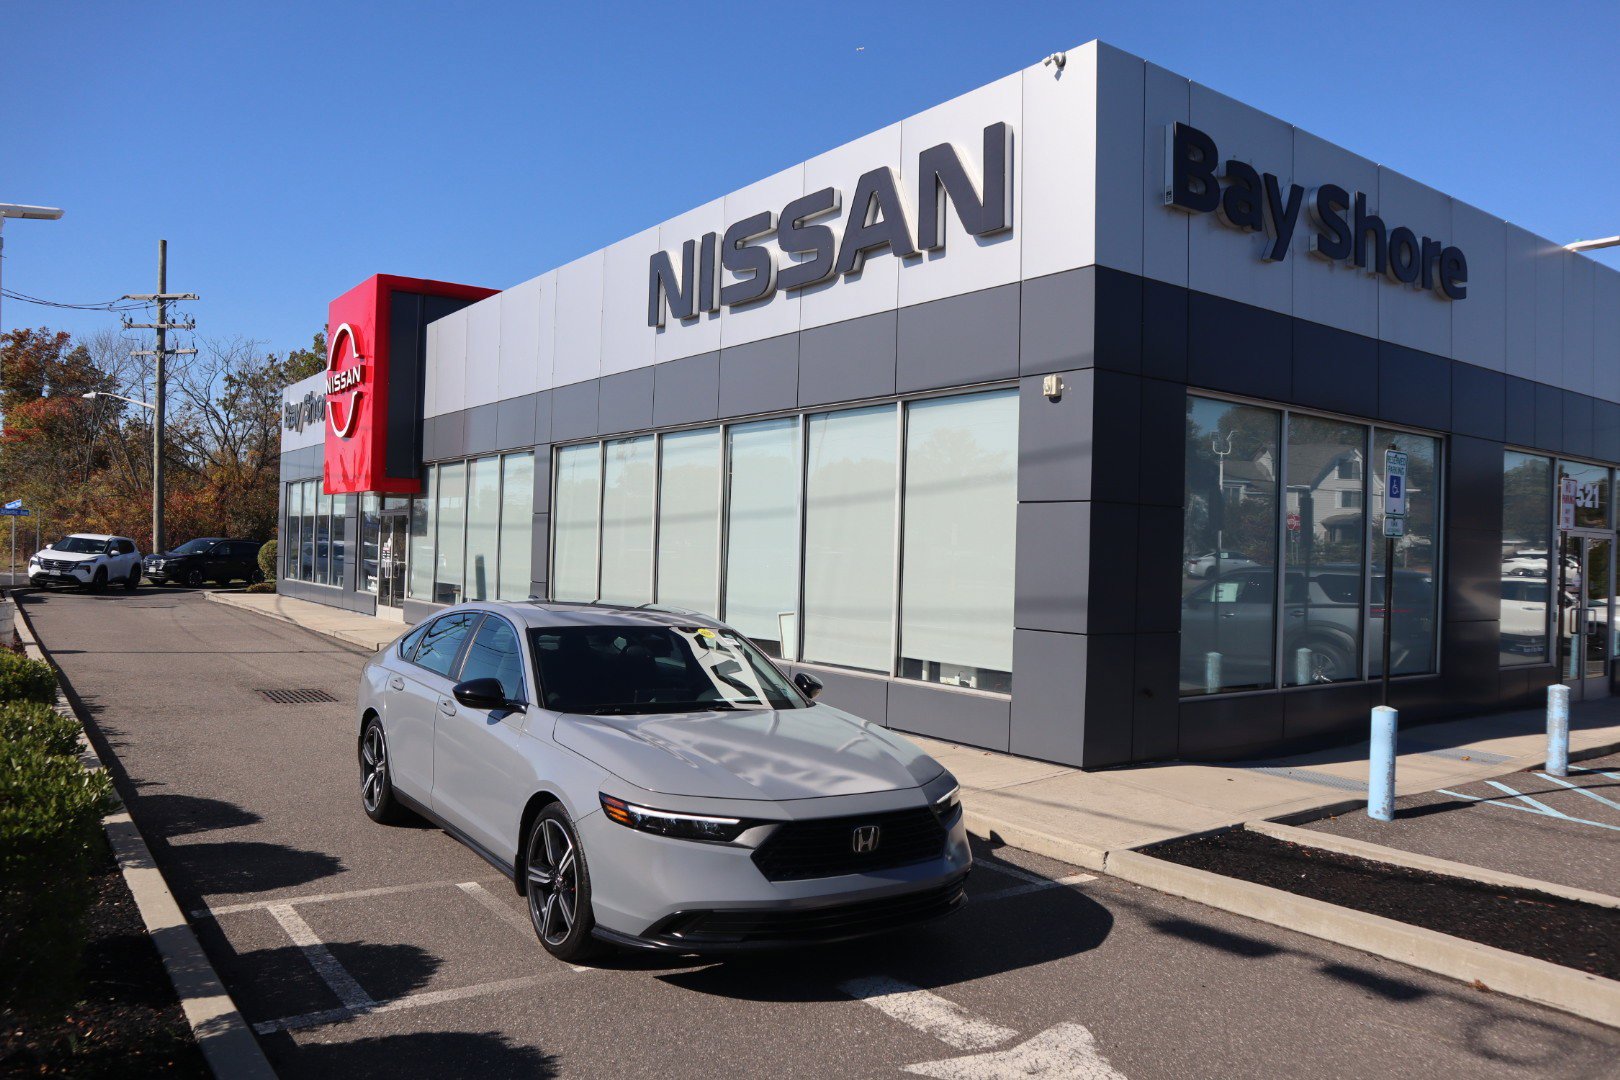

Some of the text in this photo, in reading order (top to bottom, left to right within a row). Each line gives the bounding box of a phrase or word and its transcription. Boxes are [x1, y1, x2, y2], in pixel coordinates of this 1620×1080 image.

[648, 121, 1010, 327] NISSAN
[1166, 121, 1468, 300] Bay Shore
[326, 364, 361, 395] NISSAN
[284, 391, 326, 436] Bay Shor
[1576, 484, 1599, 508] 521
